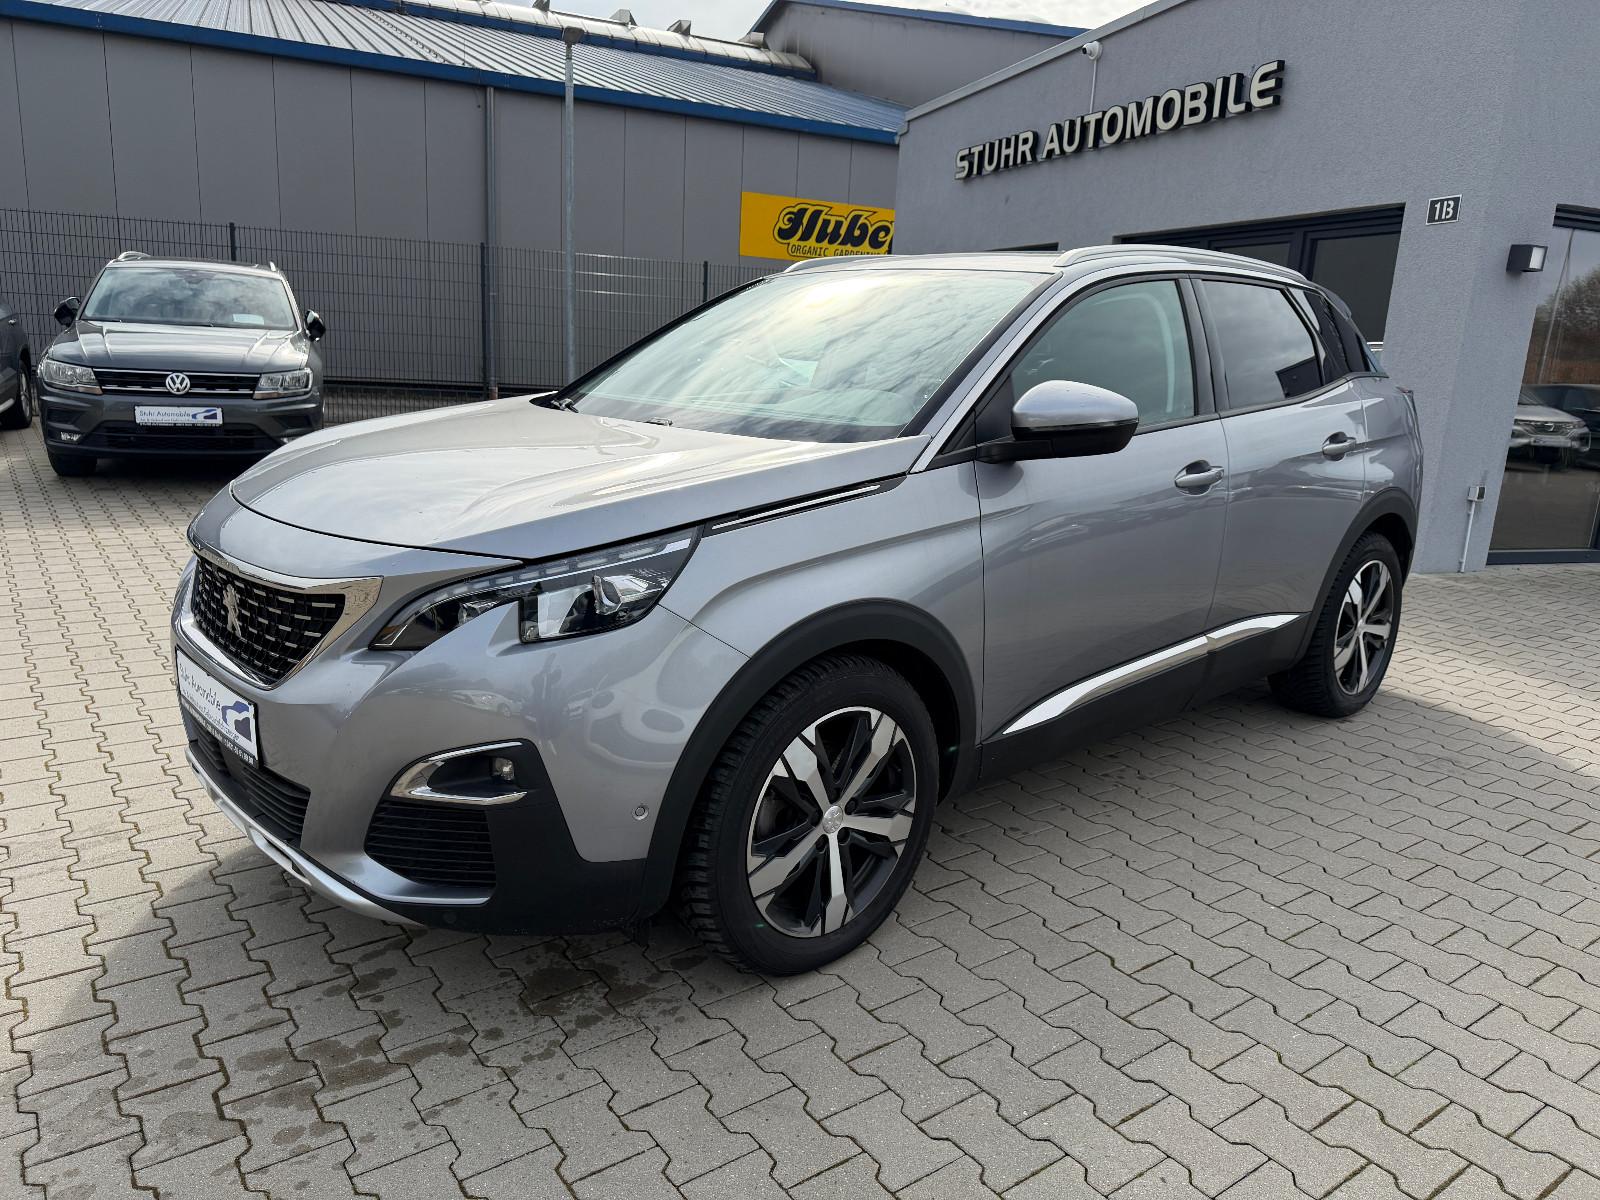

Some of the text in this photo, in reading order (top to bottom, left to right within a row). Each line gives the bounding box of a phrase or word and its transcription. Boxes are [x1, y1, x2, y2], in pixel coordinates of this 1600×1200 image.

[954, 60, 1286, 180] STUHR AUTOMOBILE
[1434, 200, 1455, 220] 1B
[777, 207, 894, 254] Hube
[790, 244, 829, 256] ORGANIC
